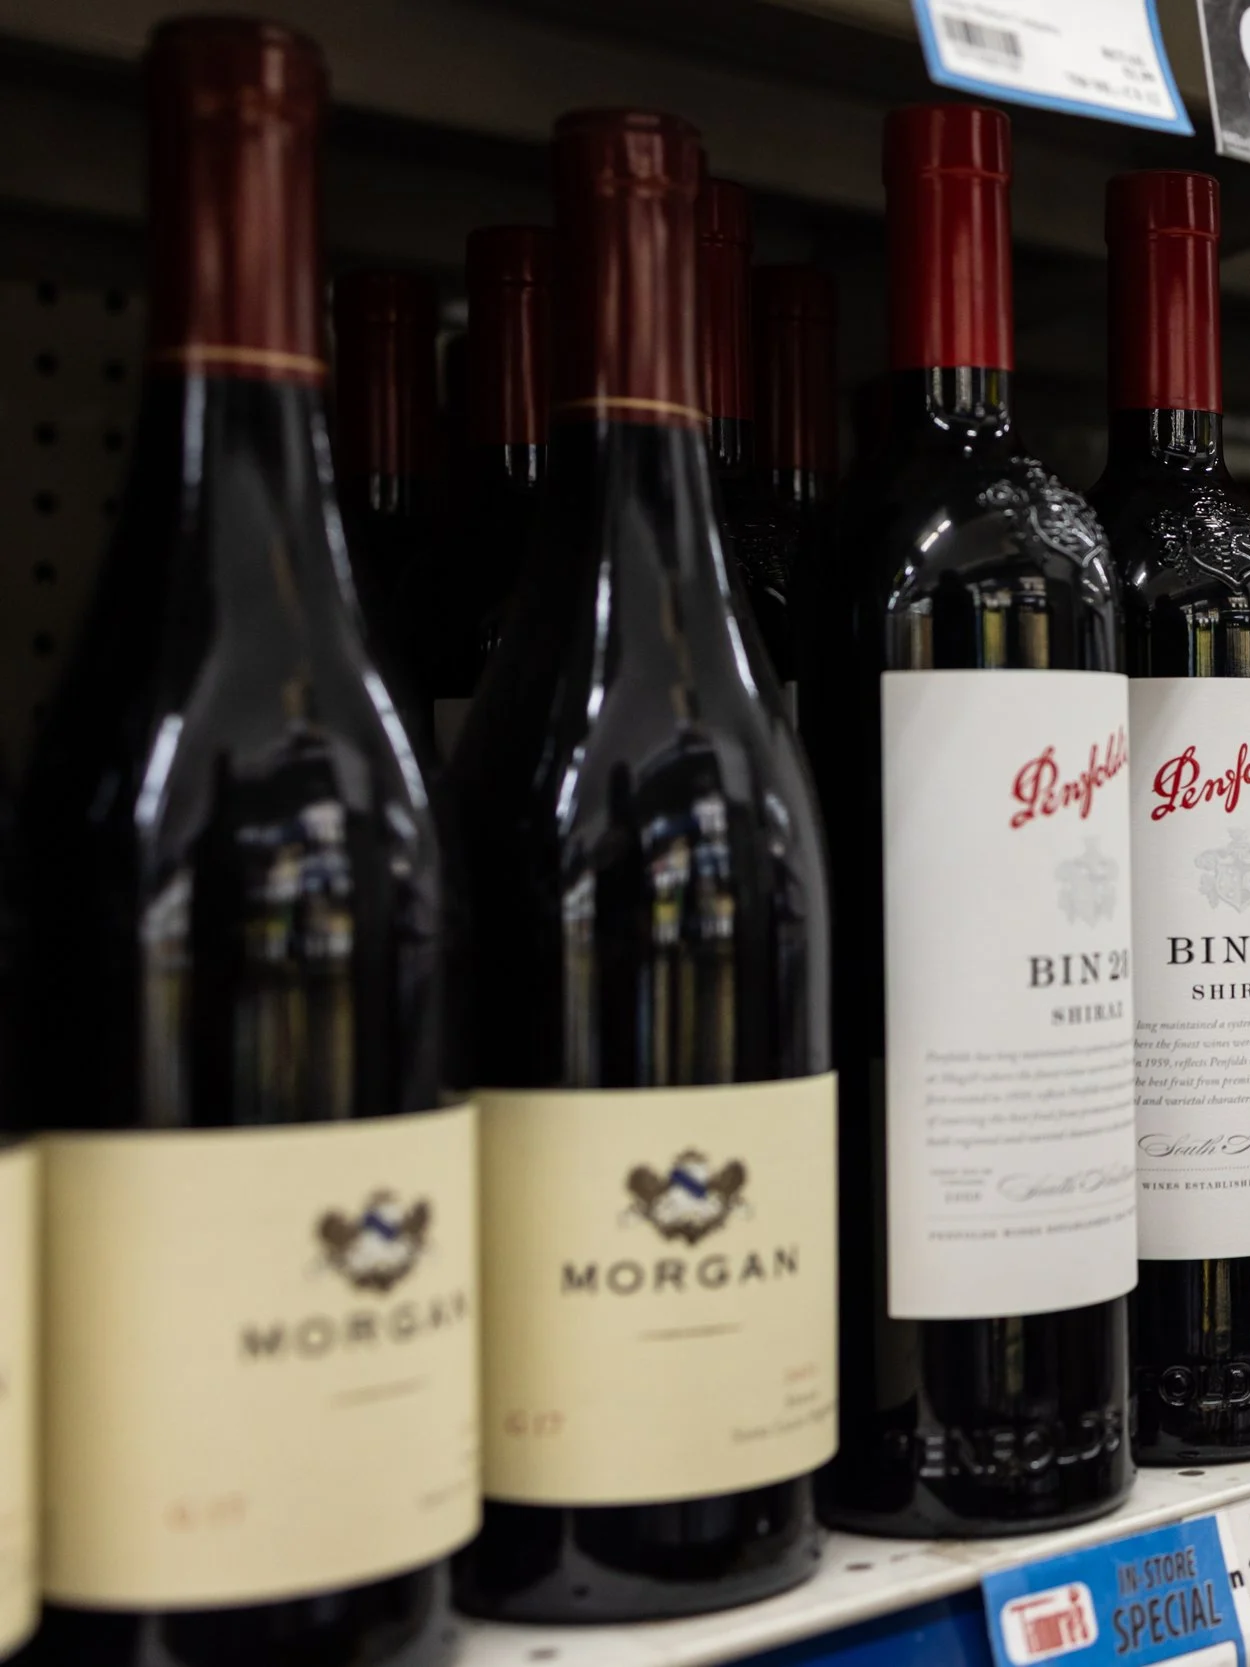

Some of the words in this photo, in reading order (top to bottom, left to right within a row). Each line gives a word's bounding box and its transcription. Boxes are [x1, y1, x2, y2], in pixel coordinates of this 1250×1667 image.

[1166, 935, 1250, 965] BIN
[1027, 951, 1101, 988] BIN
[1159, 1019, 1218, 1031] maintained
[1134, 1038, 1155, 1049] here
[1156, 1038, 1170, 1049] the
[1171, 1038, 1200, 1052] finest
[1144, 1056, 1172, 1070] 1959,
[1175, 1056, 1208, 1071] reflects
[1148, 1076, 1168, 1087] best
[1168, 1075, 1194, 1090] fruit
[1194, 1075, 1220, 1090] from
[1142, 1095, 1163, 1106] and
[1164, 1095, 1205, 1106] varietal
[1137, 1132, 1222, 1157] South
[1141, 1181, 1180, 1190] WINES
[561, 1245, 798, 1296] MORGAN
[1117, 1547, 1197, 1596] IN-STORE
[1113, 1582, 1222, 1655] SPECIAL
